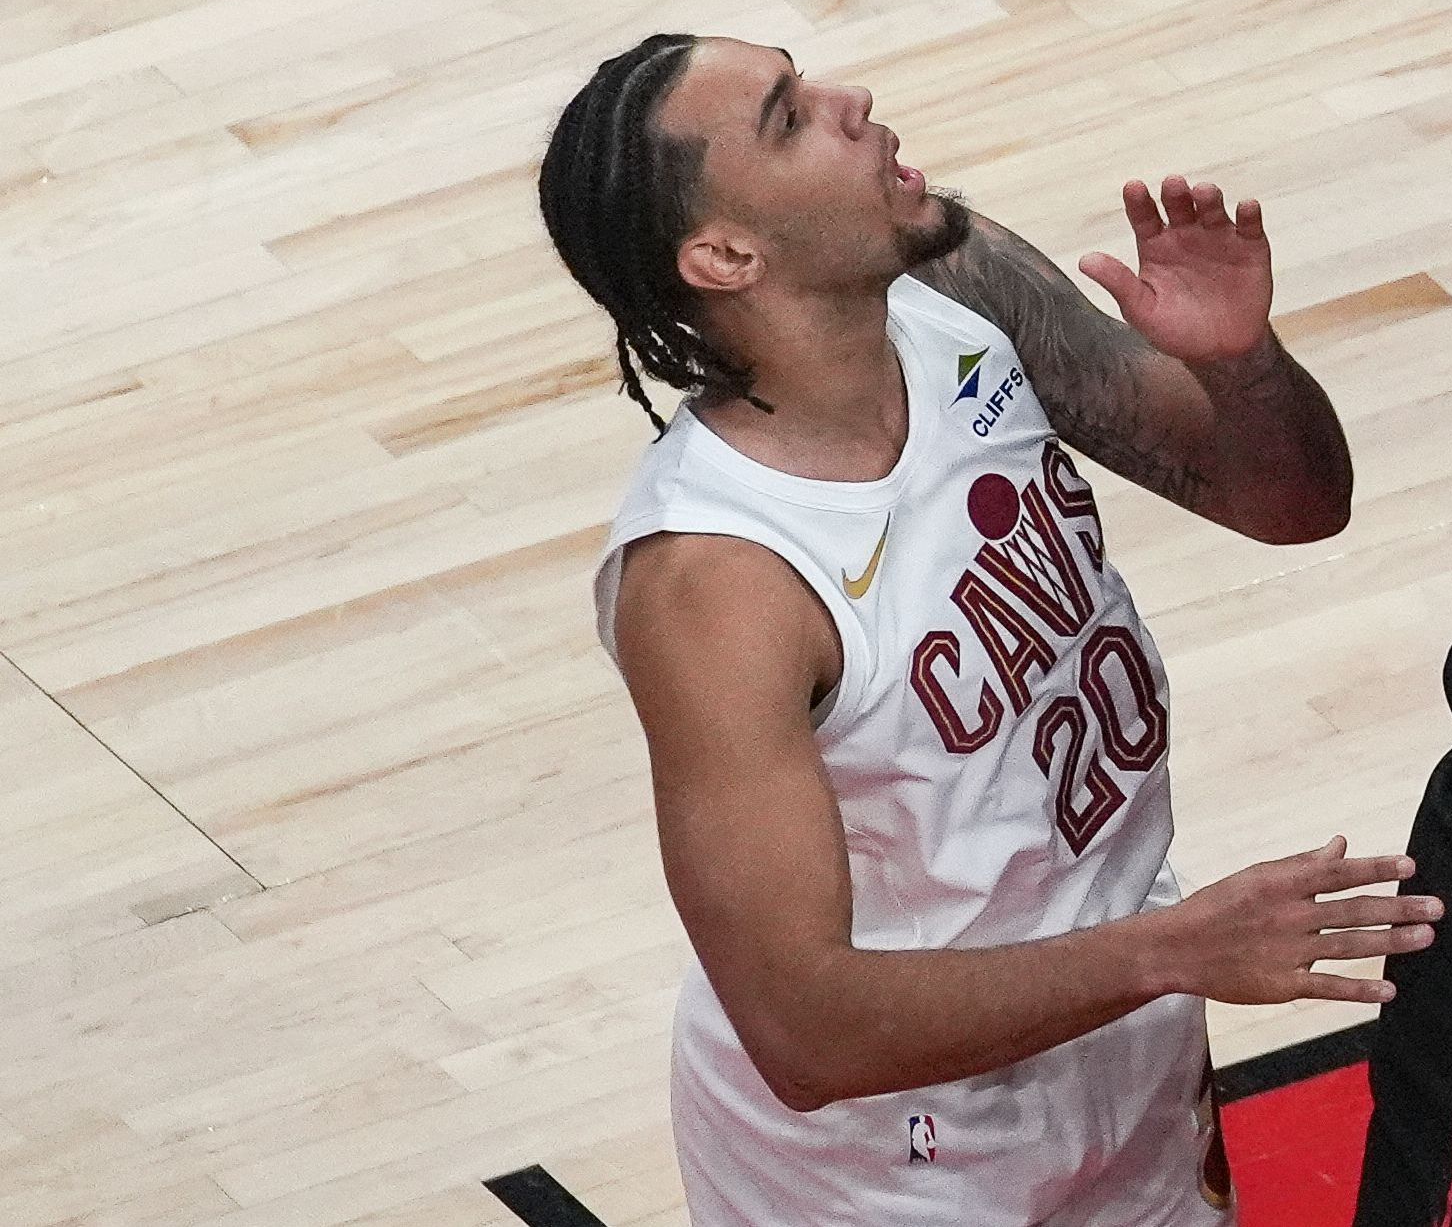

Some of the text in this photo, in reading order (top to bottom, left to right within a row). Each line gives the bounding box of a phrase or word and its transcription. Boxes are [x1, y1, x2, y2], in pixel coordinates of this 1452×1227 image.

[972, 367, 1024, 437] CLIFFS
[910, 440, 1103, 755] CAVS
[1032, 625, 1168, 858] 20
